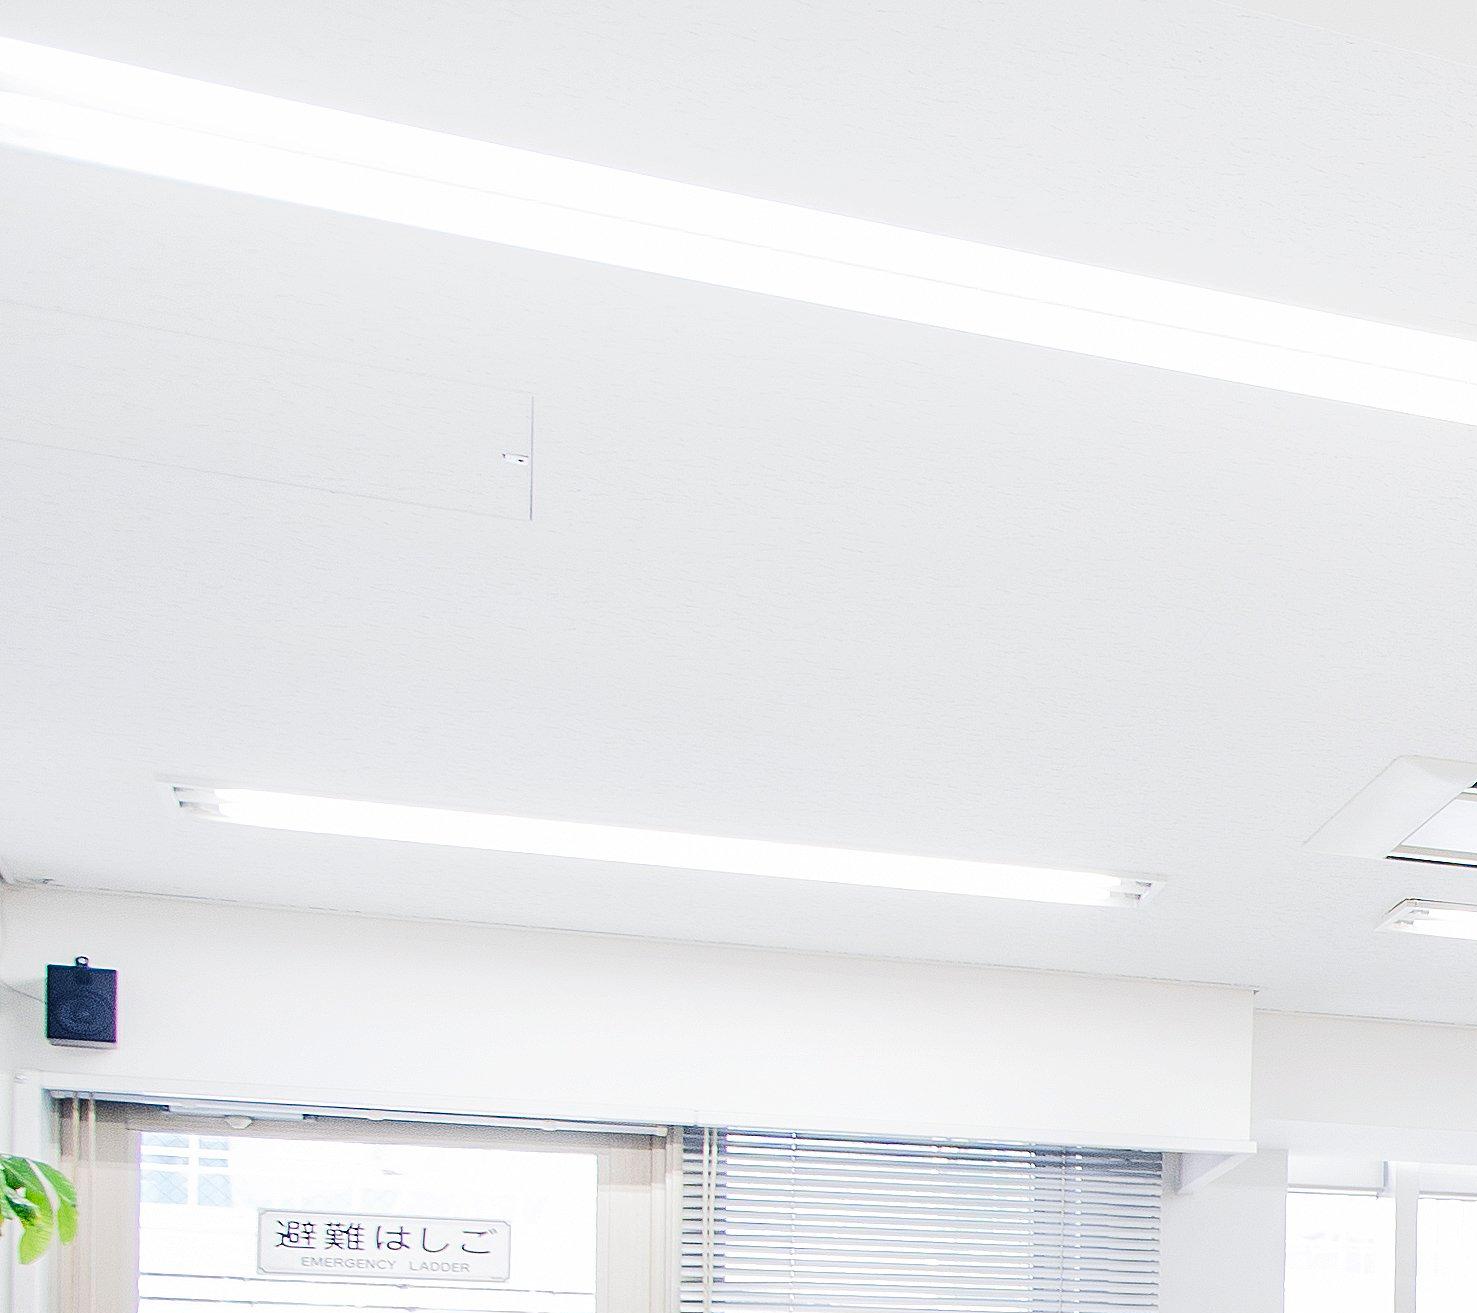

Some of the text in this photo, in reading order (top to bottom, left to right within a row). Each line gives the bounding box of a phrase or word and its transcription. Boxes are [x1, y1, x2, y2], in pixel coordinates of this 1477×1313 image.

[275, 1220, 498, 1254] 避難はしご
[301, 1256, 471, 1273] EMERGENCY LADDER
